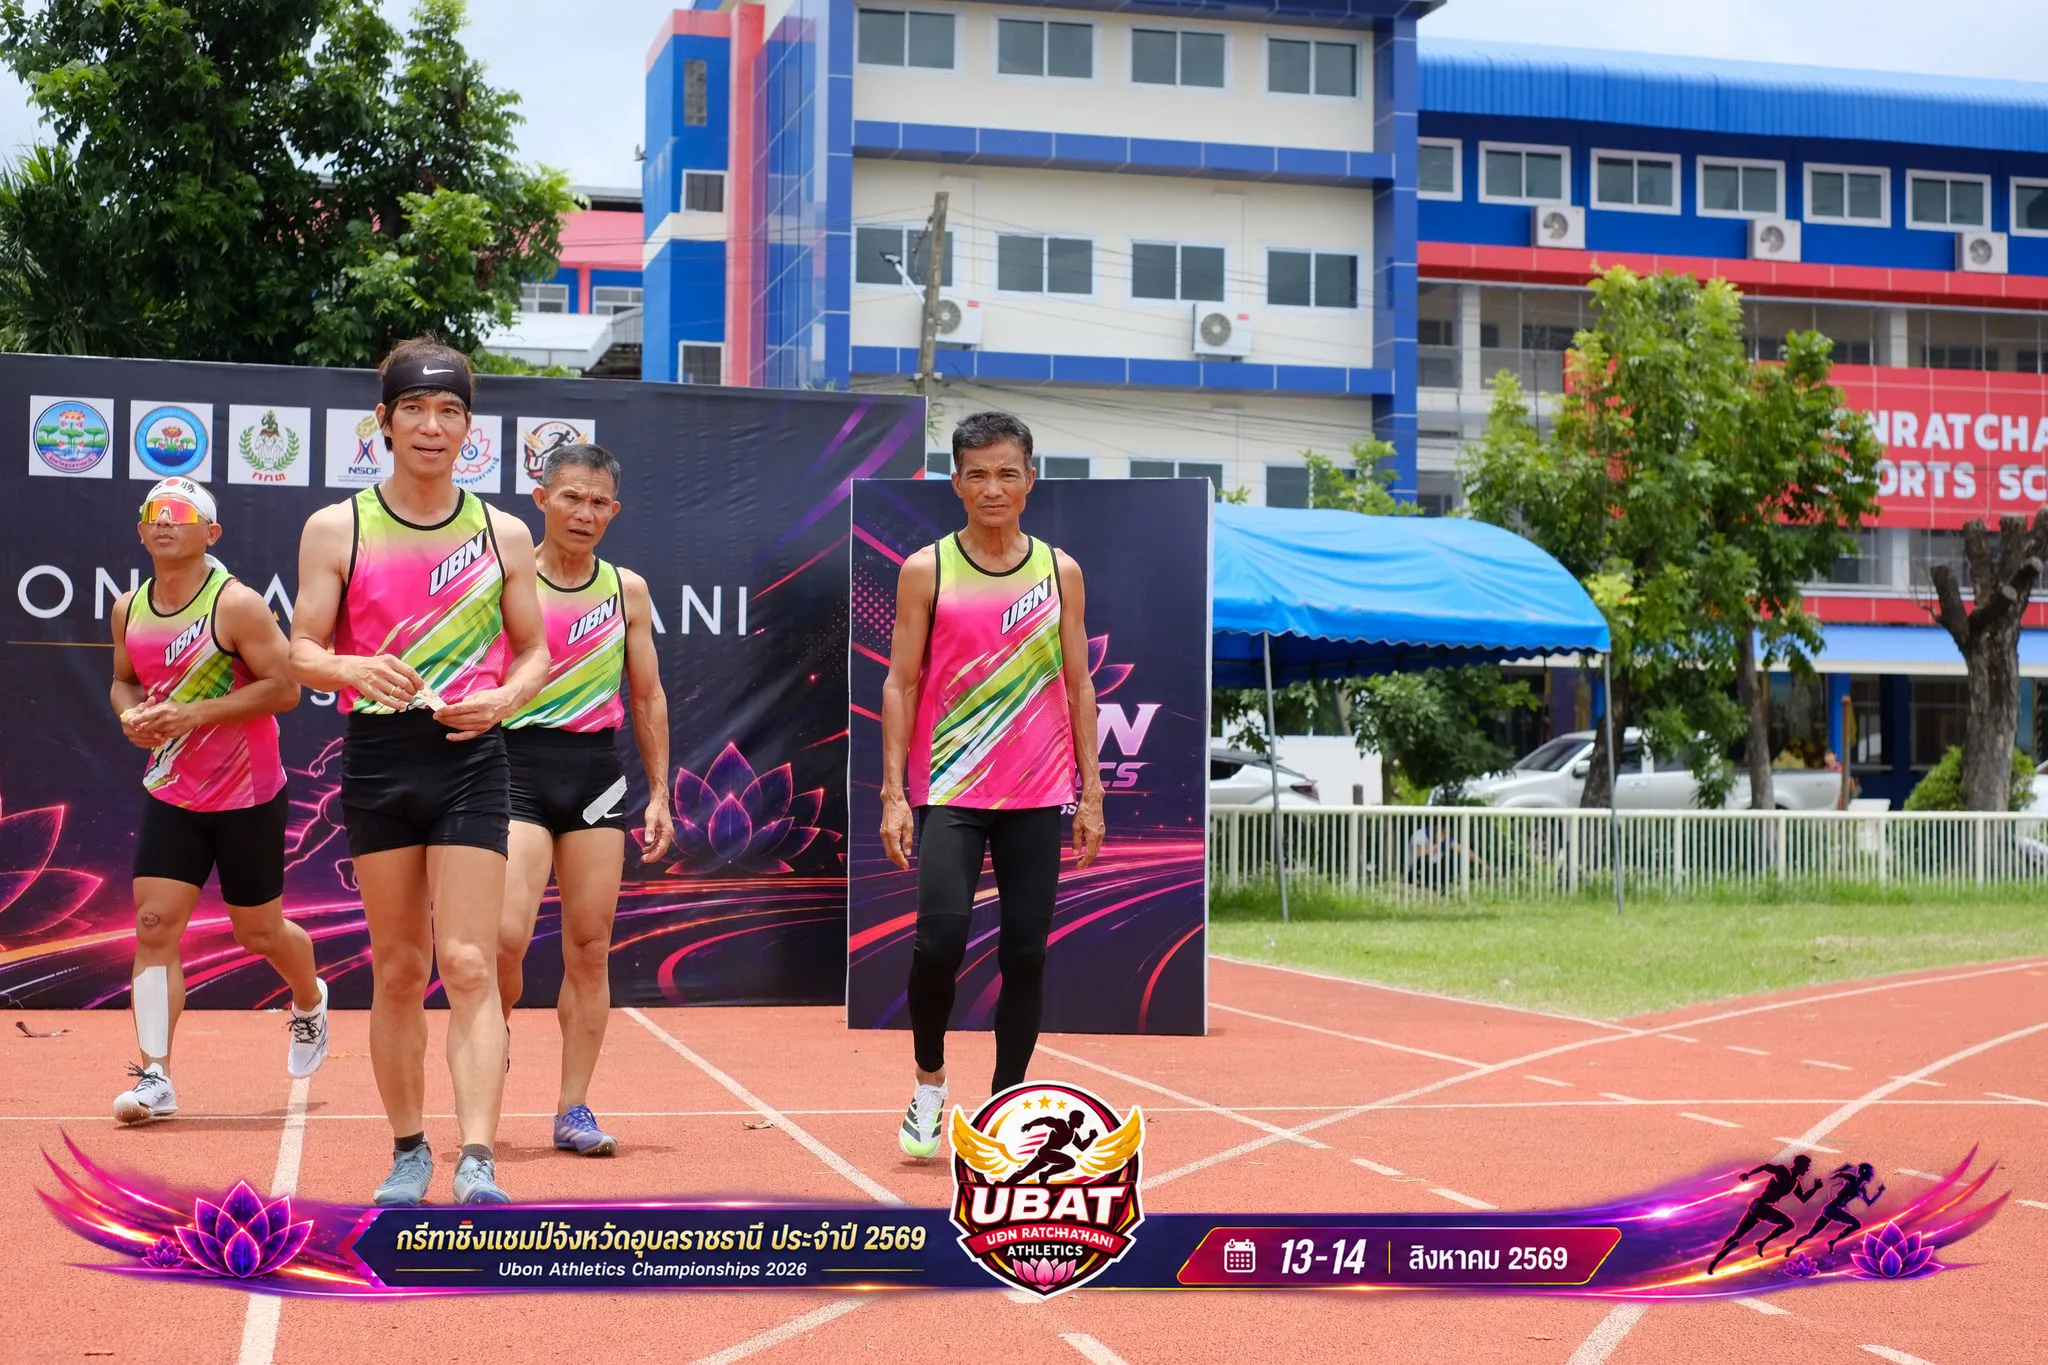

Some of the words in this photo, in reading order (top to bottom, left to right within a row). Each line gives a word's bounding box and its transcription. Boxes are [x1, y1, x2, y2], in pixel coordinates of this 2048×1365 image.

[348, 466, 381, 475] NSDF
[429, 529, 486, 596] UBN
[568, 594, 616, 645] UBN
[1002, 577, 1051, 634] UBN
[165, 615, 207, 667] UBN
